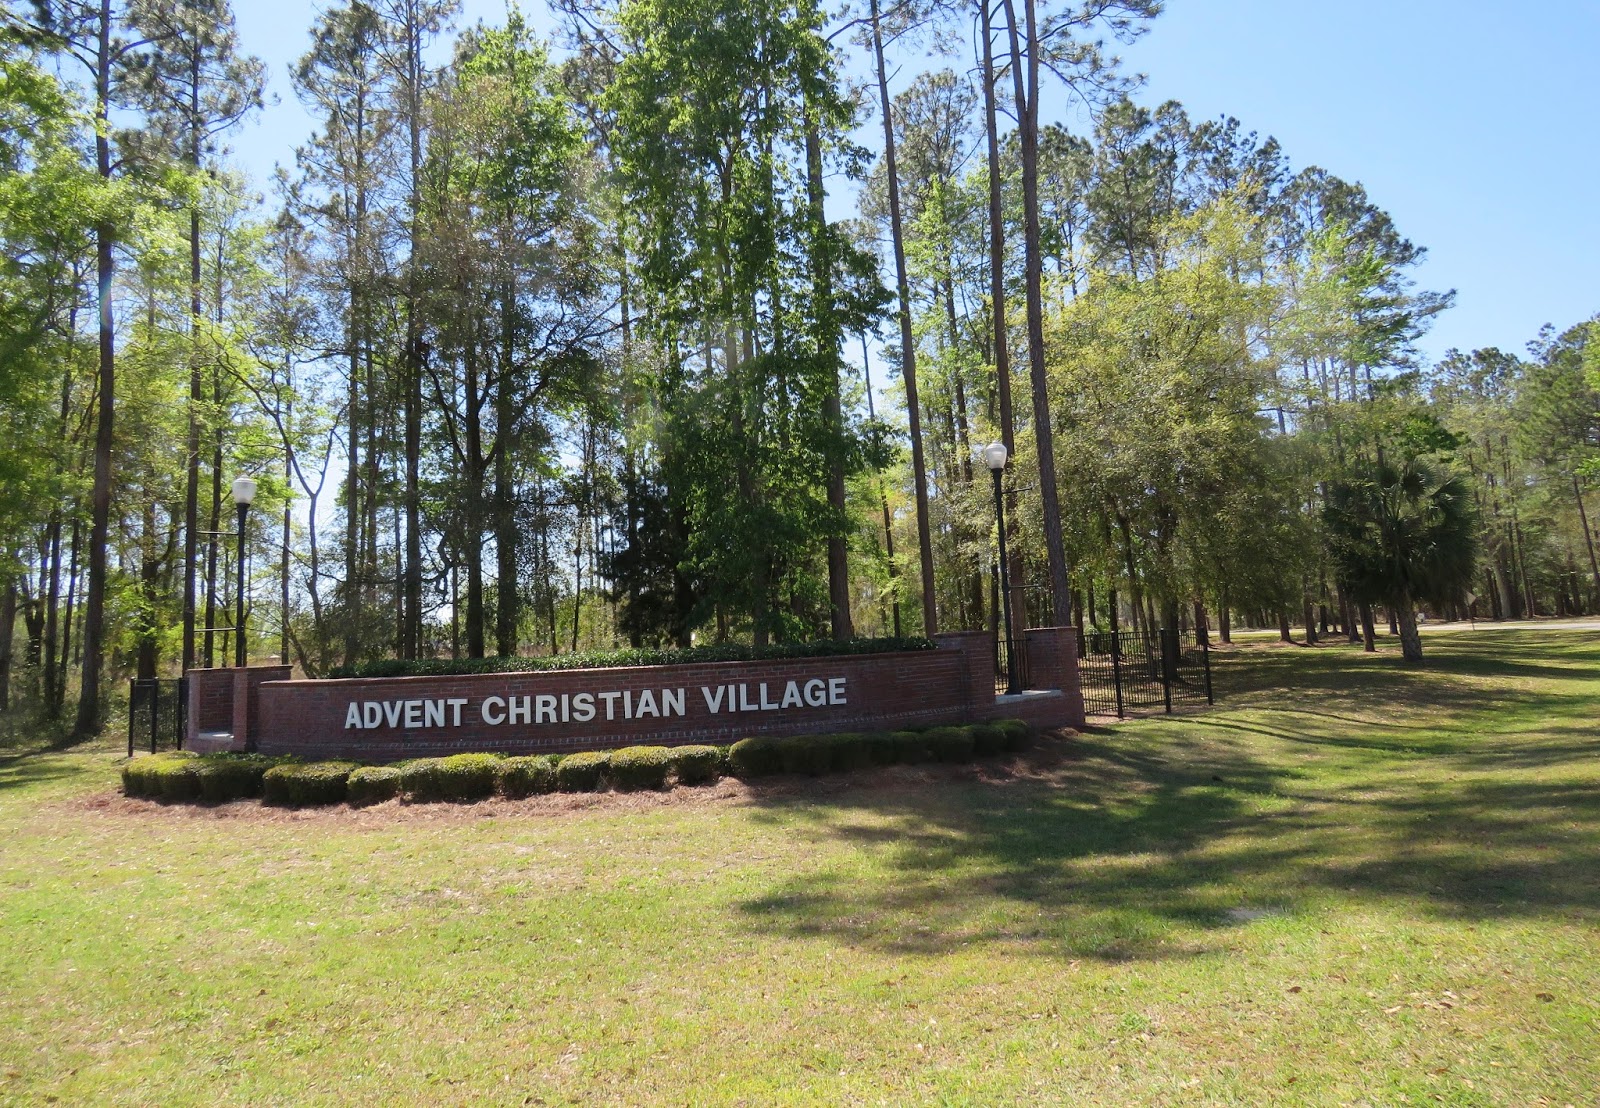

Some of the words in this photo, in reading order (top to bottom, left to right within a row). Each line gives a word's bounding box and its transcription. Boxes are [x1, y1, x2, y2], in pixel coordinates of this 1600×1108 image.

[344, 698, 469, 729] ADVENT
[481, 688, 686, 726] CHRISTIAN
[701, 677, 847, 714] VILLAGE
